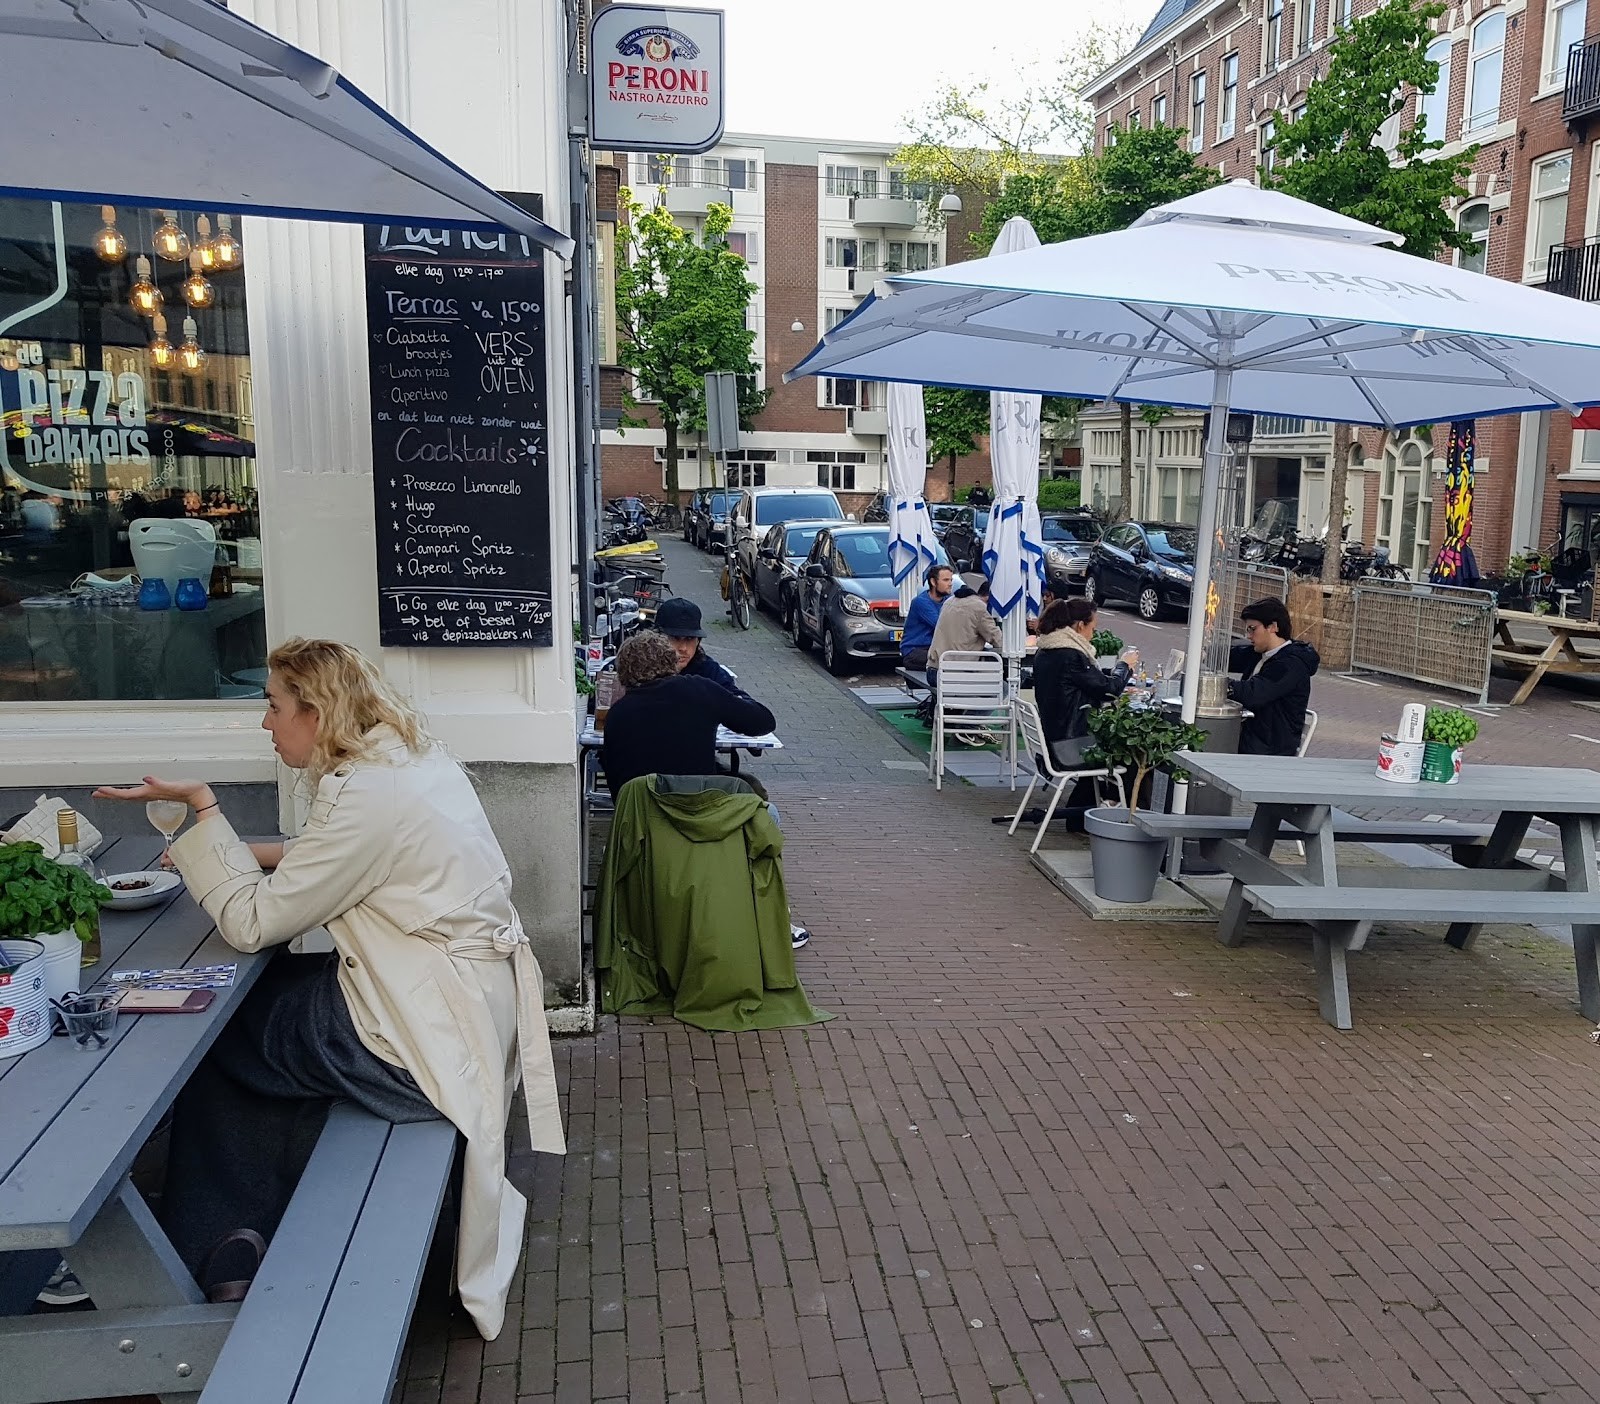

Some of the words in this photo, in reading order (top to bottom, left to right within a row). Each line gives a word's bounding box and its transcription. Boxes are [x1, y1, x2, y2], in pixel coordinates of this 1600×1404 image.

[608, 62, 709, 93] PERONI
[609, 90, 654, 103] NASTRO
[656, 92, 709, 106] AZZURRO
[394, 263, 419, 277] elke
[424, 265, 444, 284] dag
[1216, 262, 1478, 303] PERONI
[386, 290, 459, 316] Terras
[16, 343, 43, 366] de
[405, 345, 453, 365] broodjes
[475, 331, 534, 357] VERS
[389, 364, 422, 379] Lunch
[425, 367, 450, 381] pizza
[487, 356, 506, 366] uit
[511, 356, 526, 367] de
[480, 364, 535, 395] OVEN
[17, 368, 147, 428] pizza
[377, 411, 393, 421] en
[398, 411, 419, 423] dat
[424, 411, 444, 423] kan
[450, 413, 475, 425] niet
[481, 415, 516, 428] zonder
[520, 419, 546, 430] wat
[25, 427, 152, 466] bakkers
[396, 427, 518, 464] Cocktails
[95, 489, 132, 500] PIZA
[147, 429, 175, 491] PROSECCO
[402, 474, 456, 491] Prosecco
[463, 475, 521, 495] Limoncello
[405, 495, 435, 518] Hugo
[406, 514, 470, 535] Scroppino
[404, 537, 461, 557] Campari
[471, 535, 515, 558] Spritz
[462, 558, 507, 579] Spritz
[388, 593, 408, 613] To
[411, 596, 428, 612] Go
[436, 599, 460, 612] elke
[465, 599, 487, 616] dag
[424, 615, 446, 628] bel
[456, 614, 471, 628] of
[479, 614, 515, 627] bestel
[412, 630, 430, 642] via
[441, 628, 533, 643] depizzabakkers.nl
